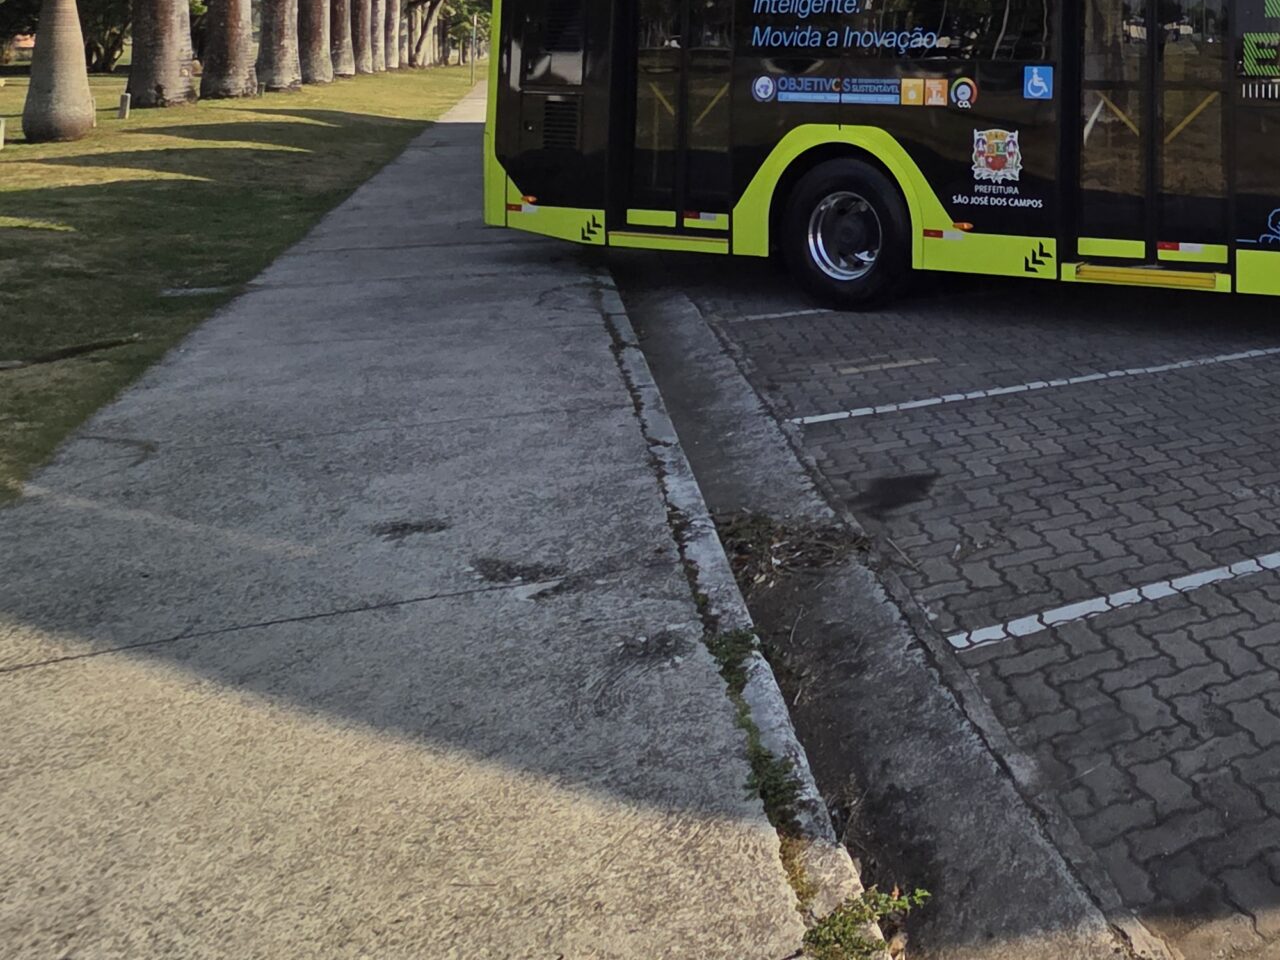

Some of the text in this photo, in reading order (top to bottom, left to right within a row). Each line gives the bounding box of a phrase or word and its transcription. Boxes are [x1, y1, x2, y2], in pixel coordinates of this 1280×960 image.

[751, 25, 822, 48] Movida
[825, 31, 838, 48] a
[974, 184, 1020, 195] PREFEITURA
[952, 194, 1043, 209] SÃO JOSÉ DOS CAMPOS
